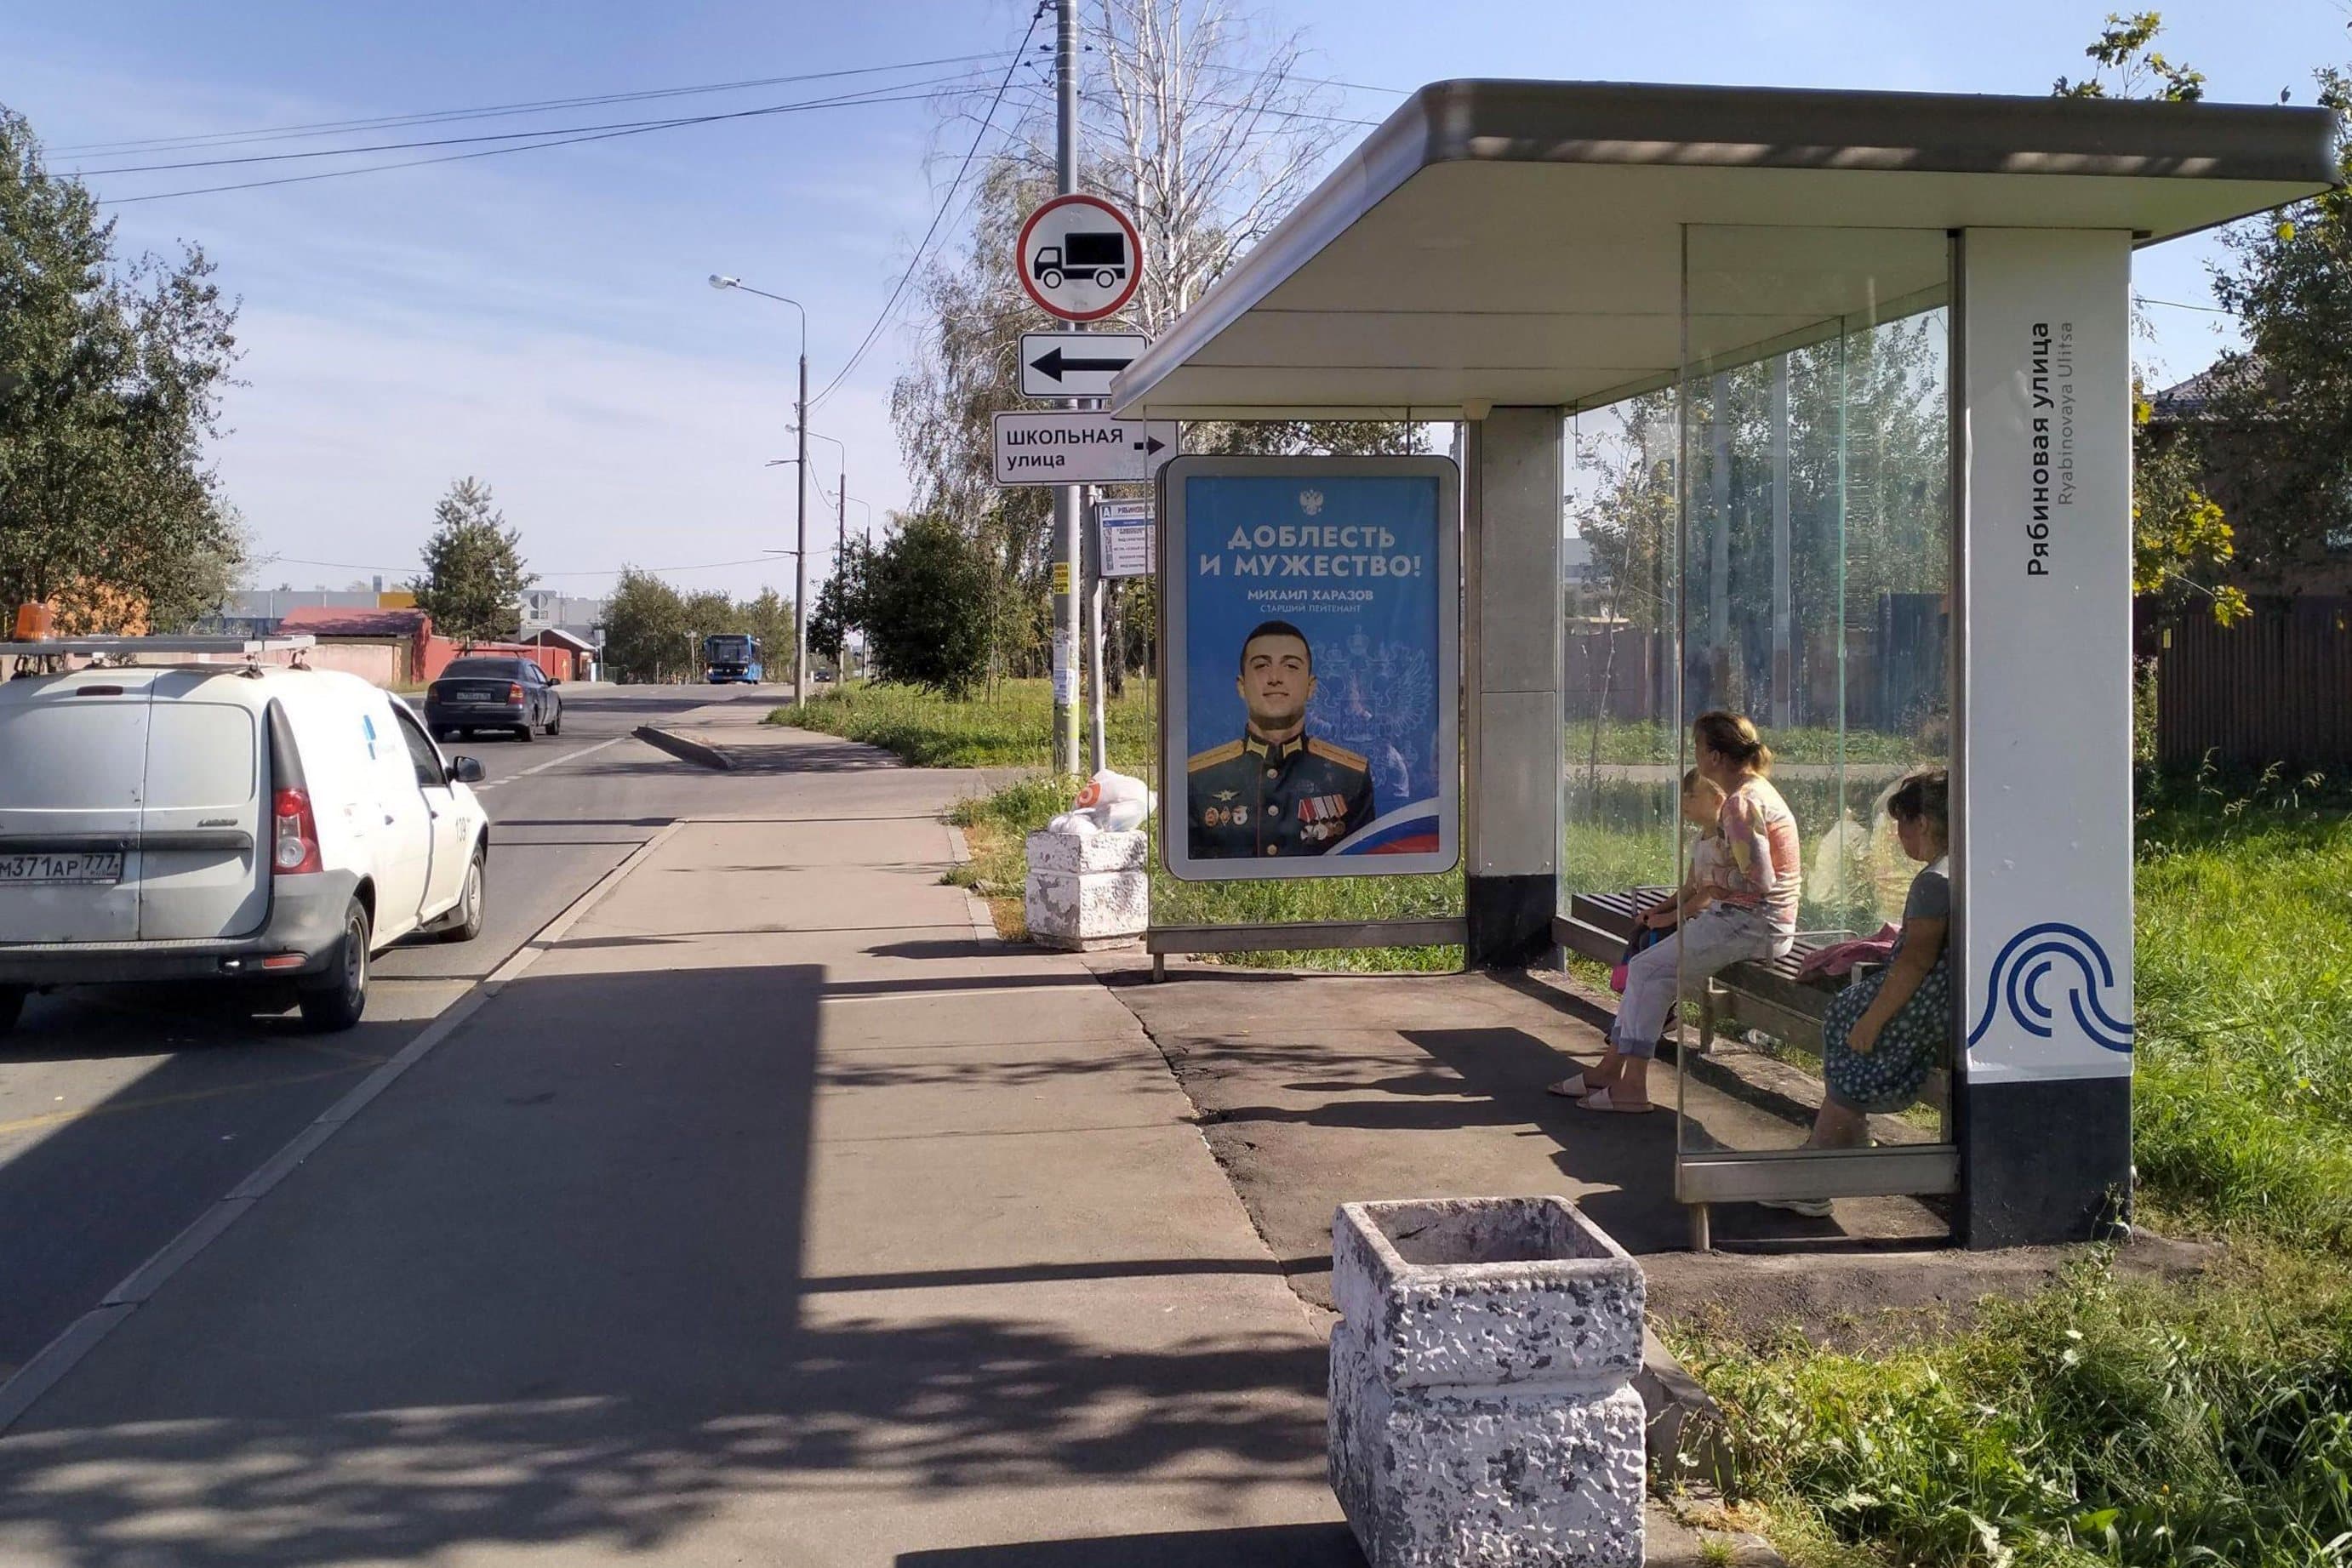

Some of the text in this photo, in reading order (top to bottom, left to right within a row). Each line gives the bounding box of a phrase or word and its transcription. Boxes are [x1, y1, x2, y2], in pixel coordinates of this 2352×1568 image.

[2057, 322, 2076, 505] Ryabinovaya Ulitsa
[1007, 429, 1123, 446] ШКОЛЬНАЯ
[2027, 322, 2054, 575] Рябиновая улица
[1007, 454, 1065, 470] улица
[1228, 524, 1396, 550] ДОБЛЕСТЬ
[1200, 554, 1421, 577] И МУЖЕСТВО!
[1247, 590, 1374, 600] МИХАИЛ ХАРАЗОВ
[1260, 603, 1361, 613] СТАРШИЙ ЛЕЙТЕНАНТ
